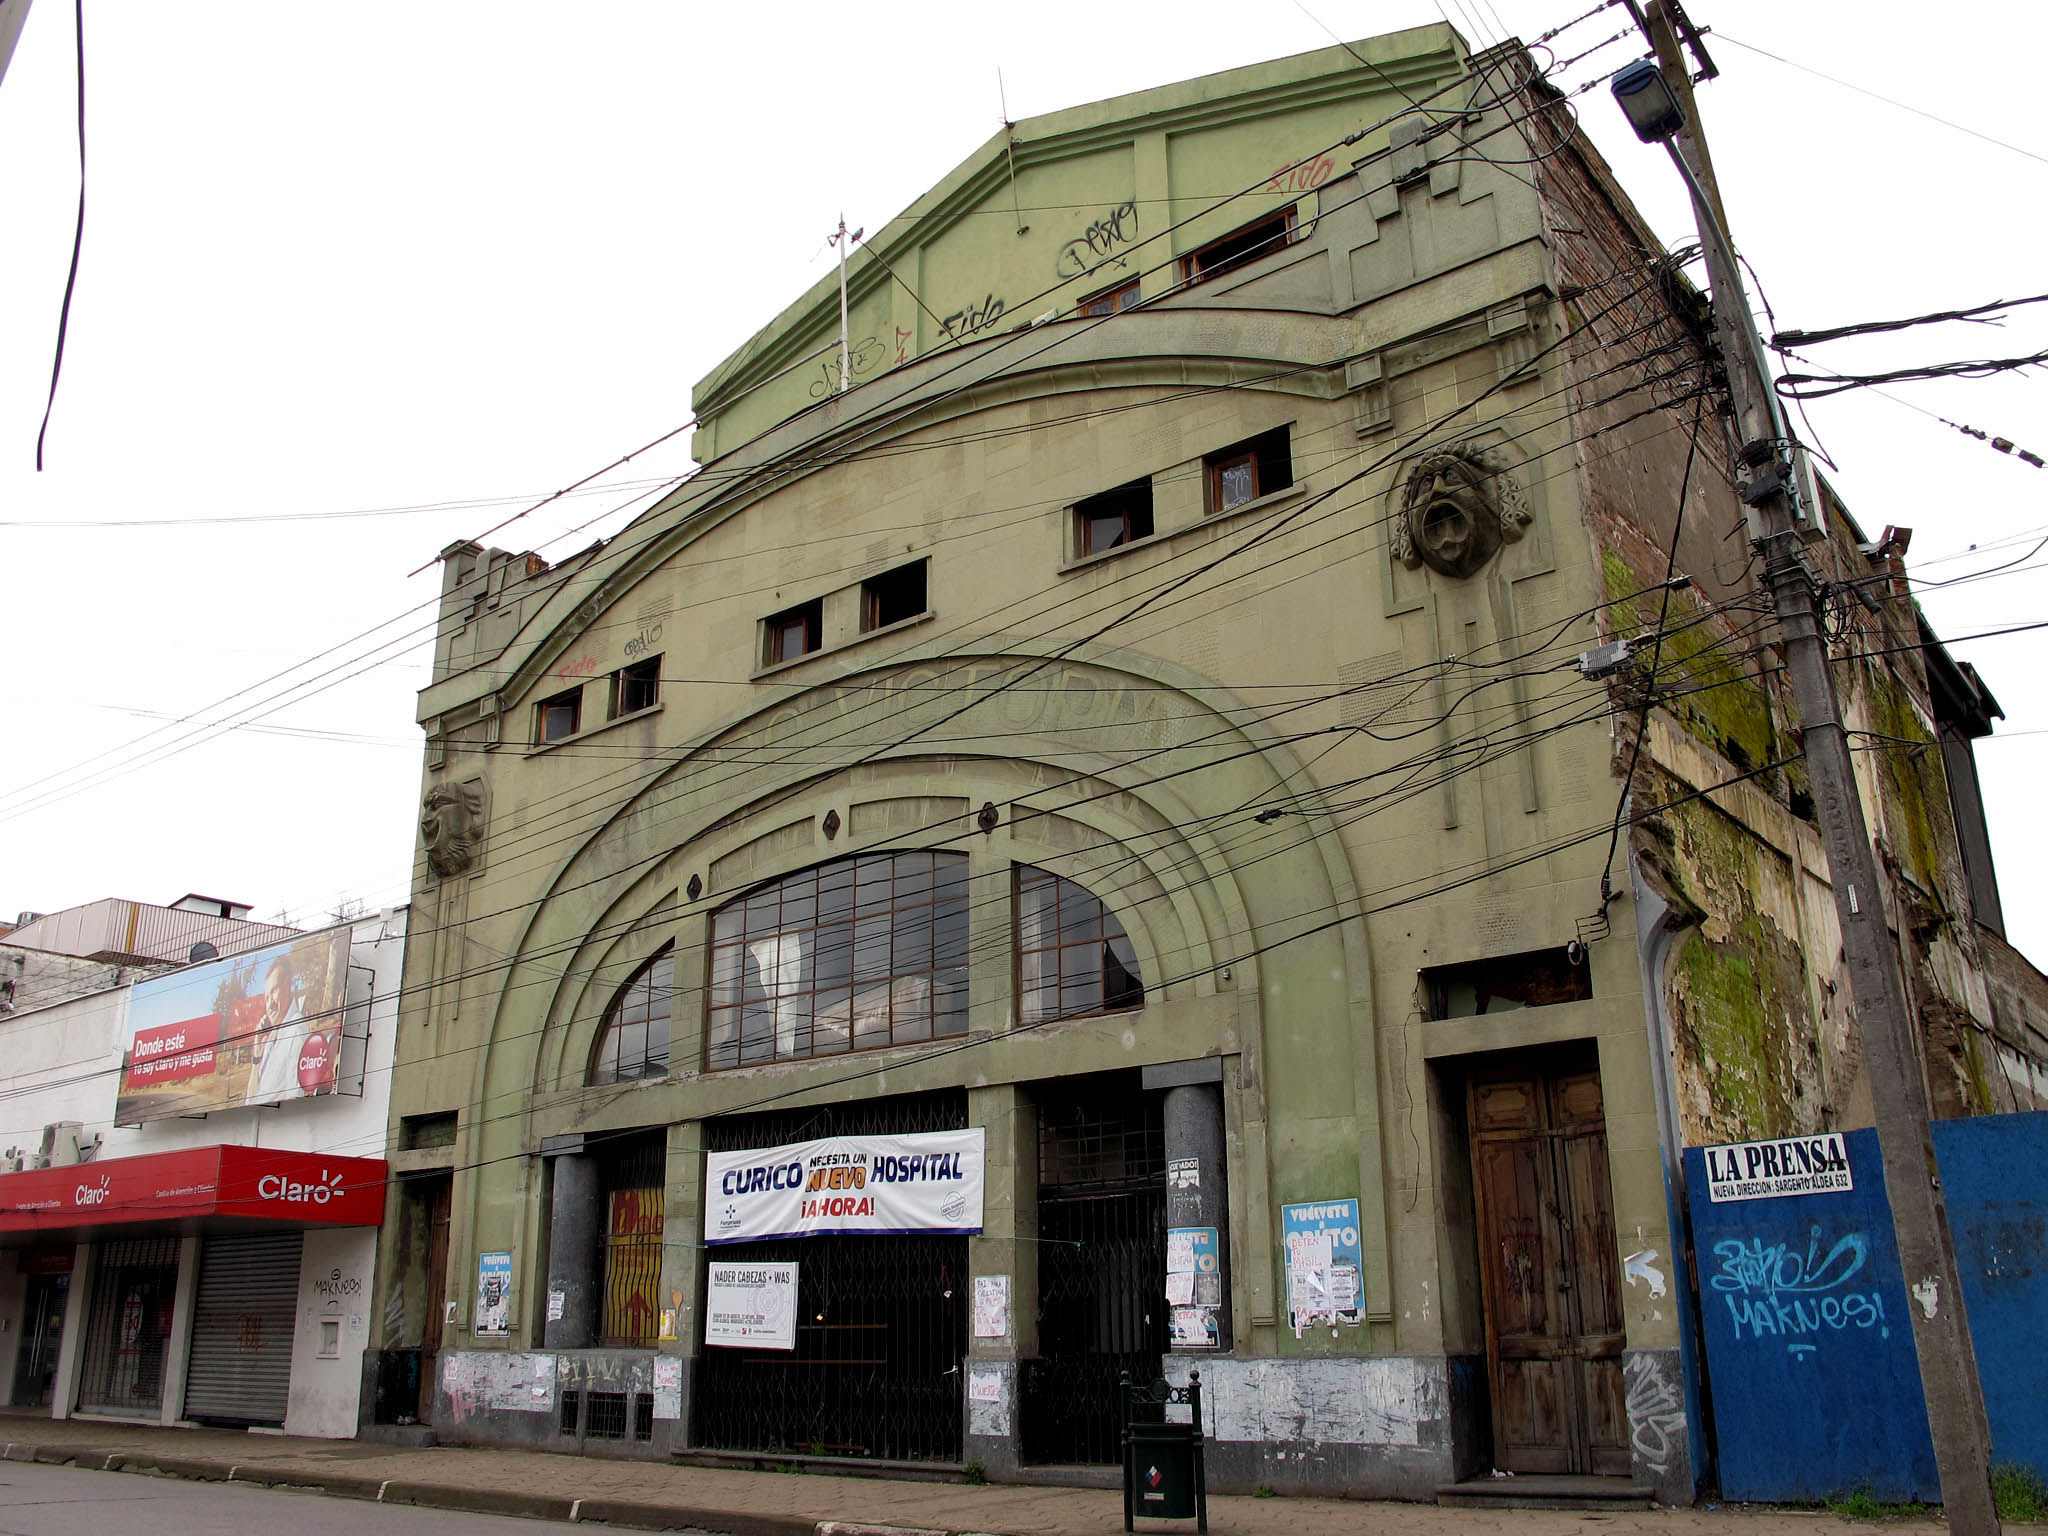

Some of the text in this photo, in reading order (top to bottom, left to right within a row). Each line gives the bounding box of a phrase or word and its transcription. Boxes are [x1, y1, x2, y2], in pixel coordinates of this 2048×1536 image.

[135, 1029, 185, 1057] Donde esté
[155, 1058, 174, 1072] Claro
[299, 1051, 323, 1071] Claro
[809, 1153, 867, 1168] NECESITA UN
[870, 1152, 963, 1183] HOSPITAL
[1708, 1138, 1846, 1183] LA PRENSA
[722, 1156, 803, 1196] CURICÓ
[805, 1166, 866, 1192] NUEVO
[1713, 1185, 1736, 1198] NUEVA
[1774, 1177, 1810, 1192] SARGENTO
[1812, 1175, 1834, 1189] ALDEA
[1835, 1173, 1848, 1187] 632
[75, 1184, 105, 1206] Claro
[258, 1174, 331, 1204] Claro
[801, 1197, 875, 1219] ¡AHORA!
[714, 1270, 736, 1283] NADER
[737, 1271, 767, 1284] CABEZAS
[774, 1271, 791, 1284] WAS
